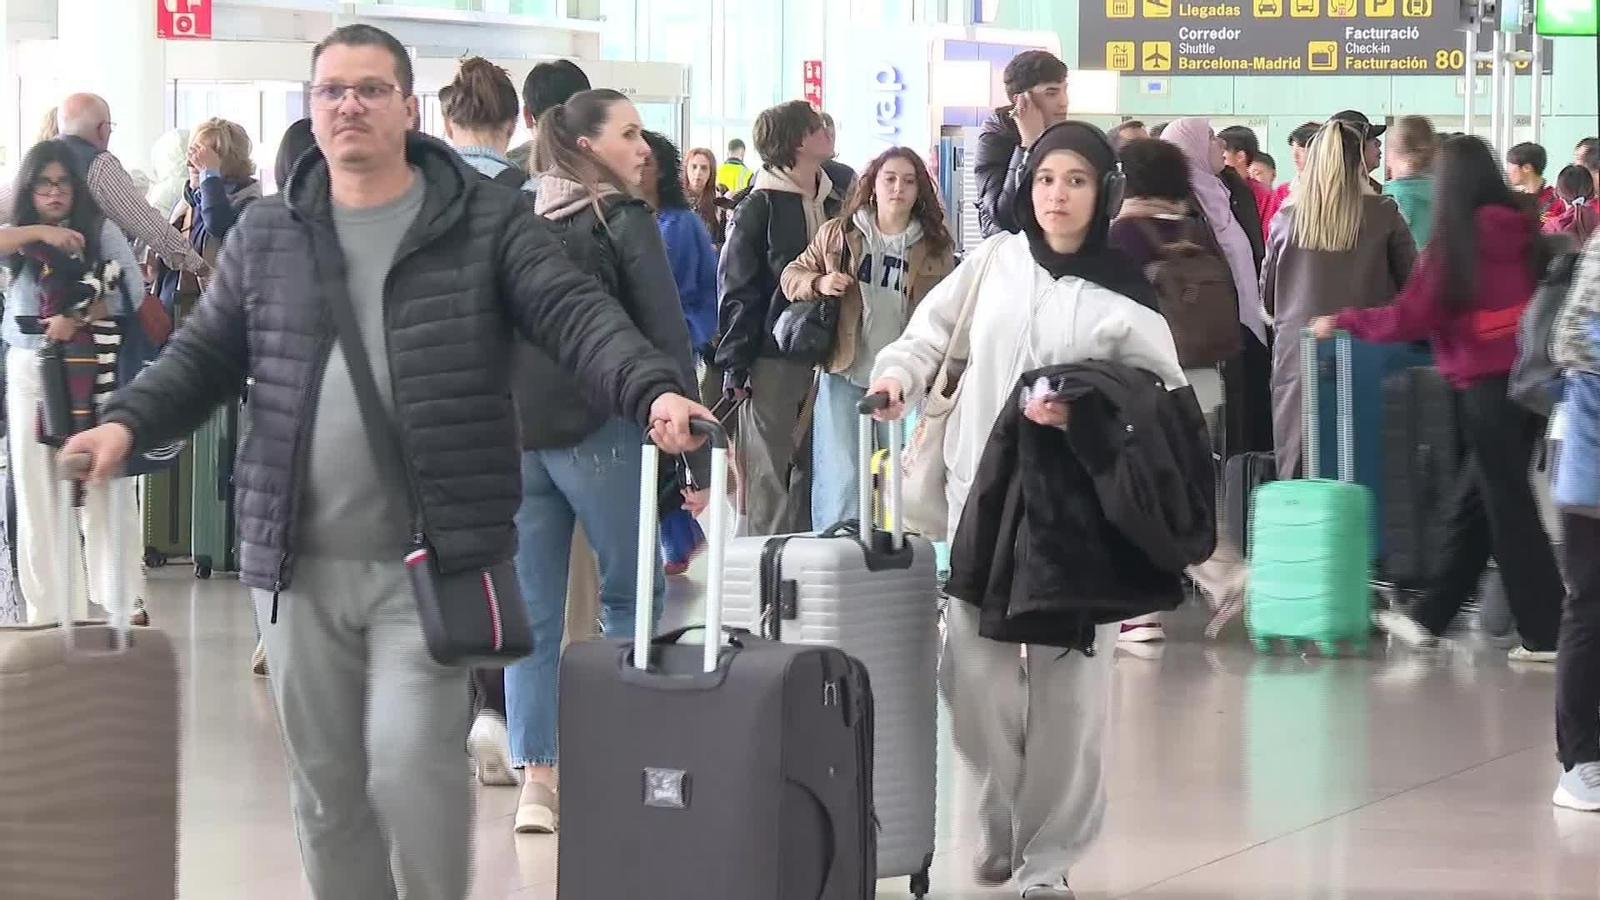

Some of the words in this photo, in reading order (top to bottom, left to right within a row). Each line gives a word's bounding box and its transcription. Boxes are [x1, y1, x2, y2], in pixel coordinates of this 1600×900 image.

[1178, 3, 1241, 18] Llegadas
[1178, 27, 1241, 40] Corredor
[1345, 26, 1420, 40] Facturació
[1178, 43, 1216, 54] Shuttle
[1345, 42, 1391, 54] Check-in
[1178, 56, 1301, 70] Barcelona-Madrid
[1345, 56, 1428, 70] Facturación
[1435, 49, 1464, 70] 80
